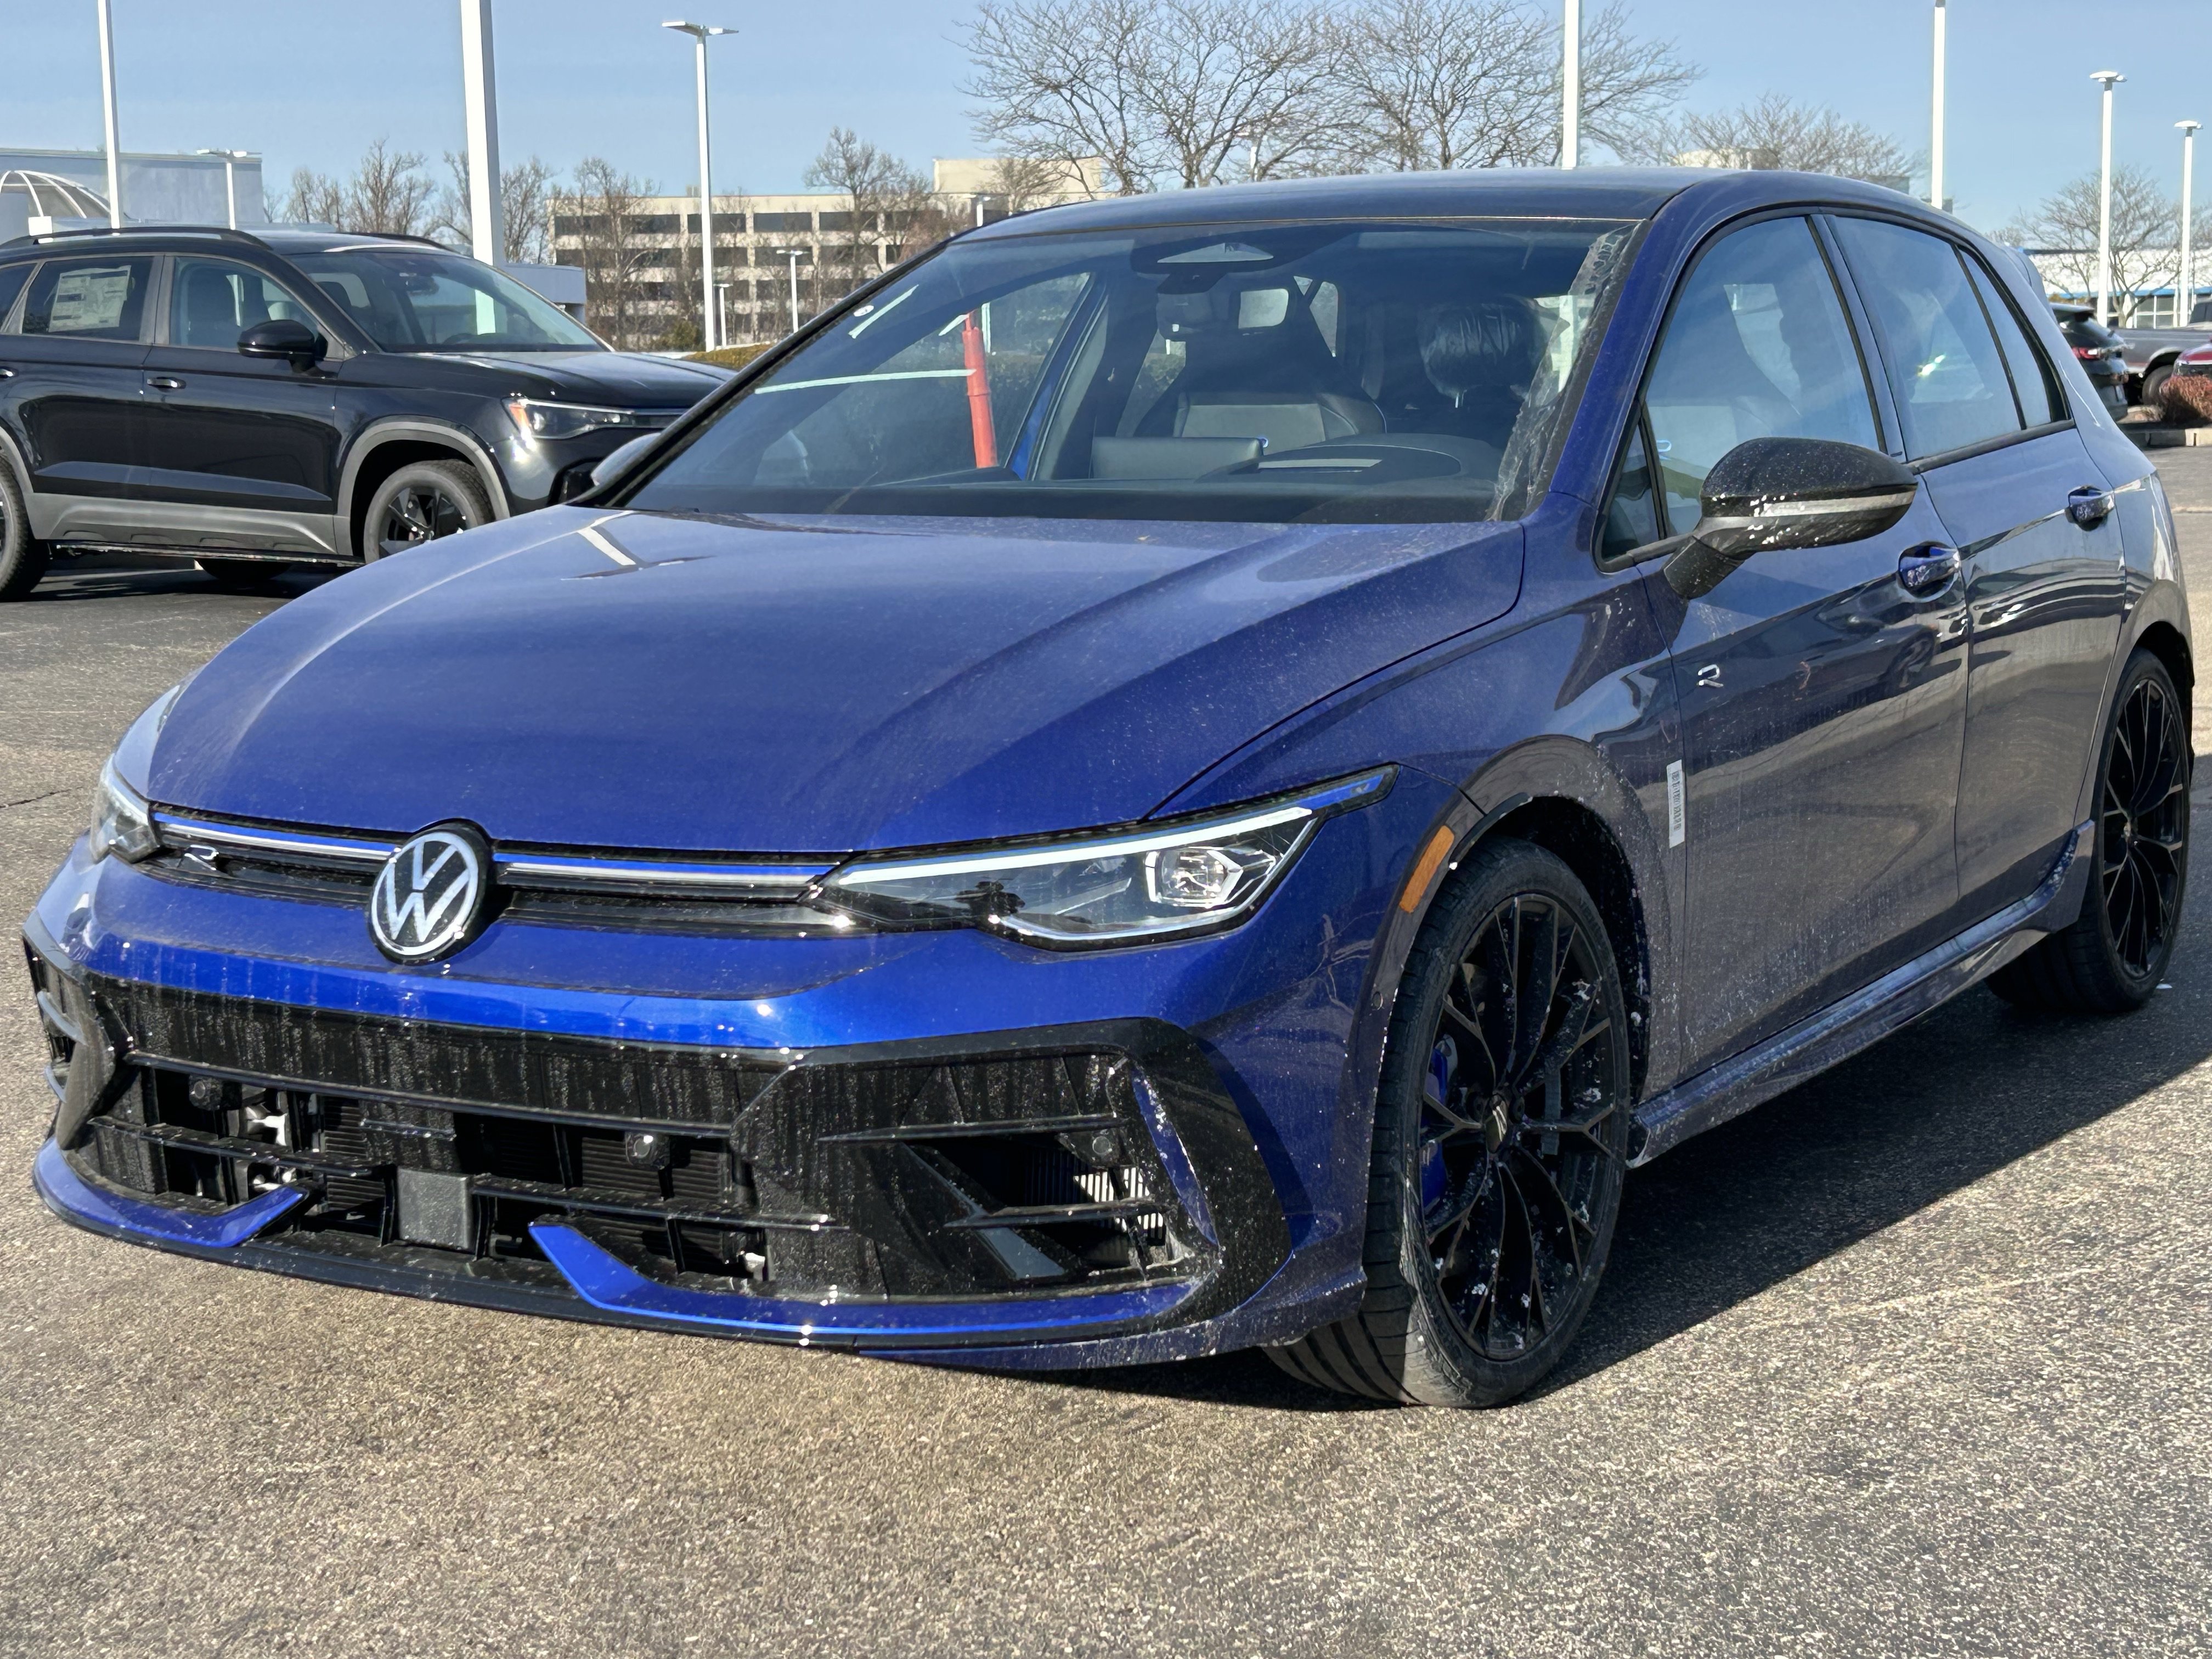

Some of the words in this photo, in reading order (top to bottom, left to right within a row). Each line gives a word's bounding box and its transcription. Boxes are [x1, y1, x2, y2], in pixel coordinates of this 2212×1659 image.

[1697, 664, 1724, 688] R
[184, 844, 219, 871] R
[384, 839, 472, 943] VW
